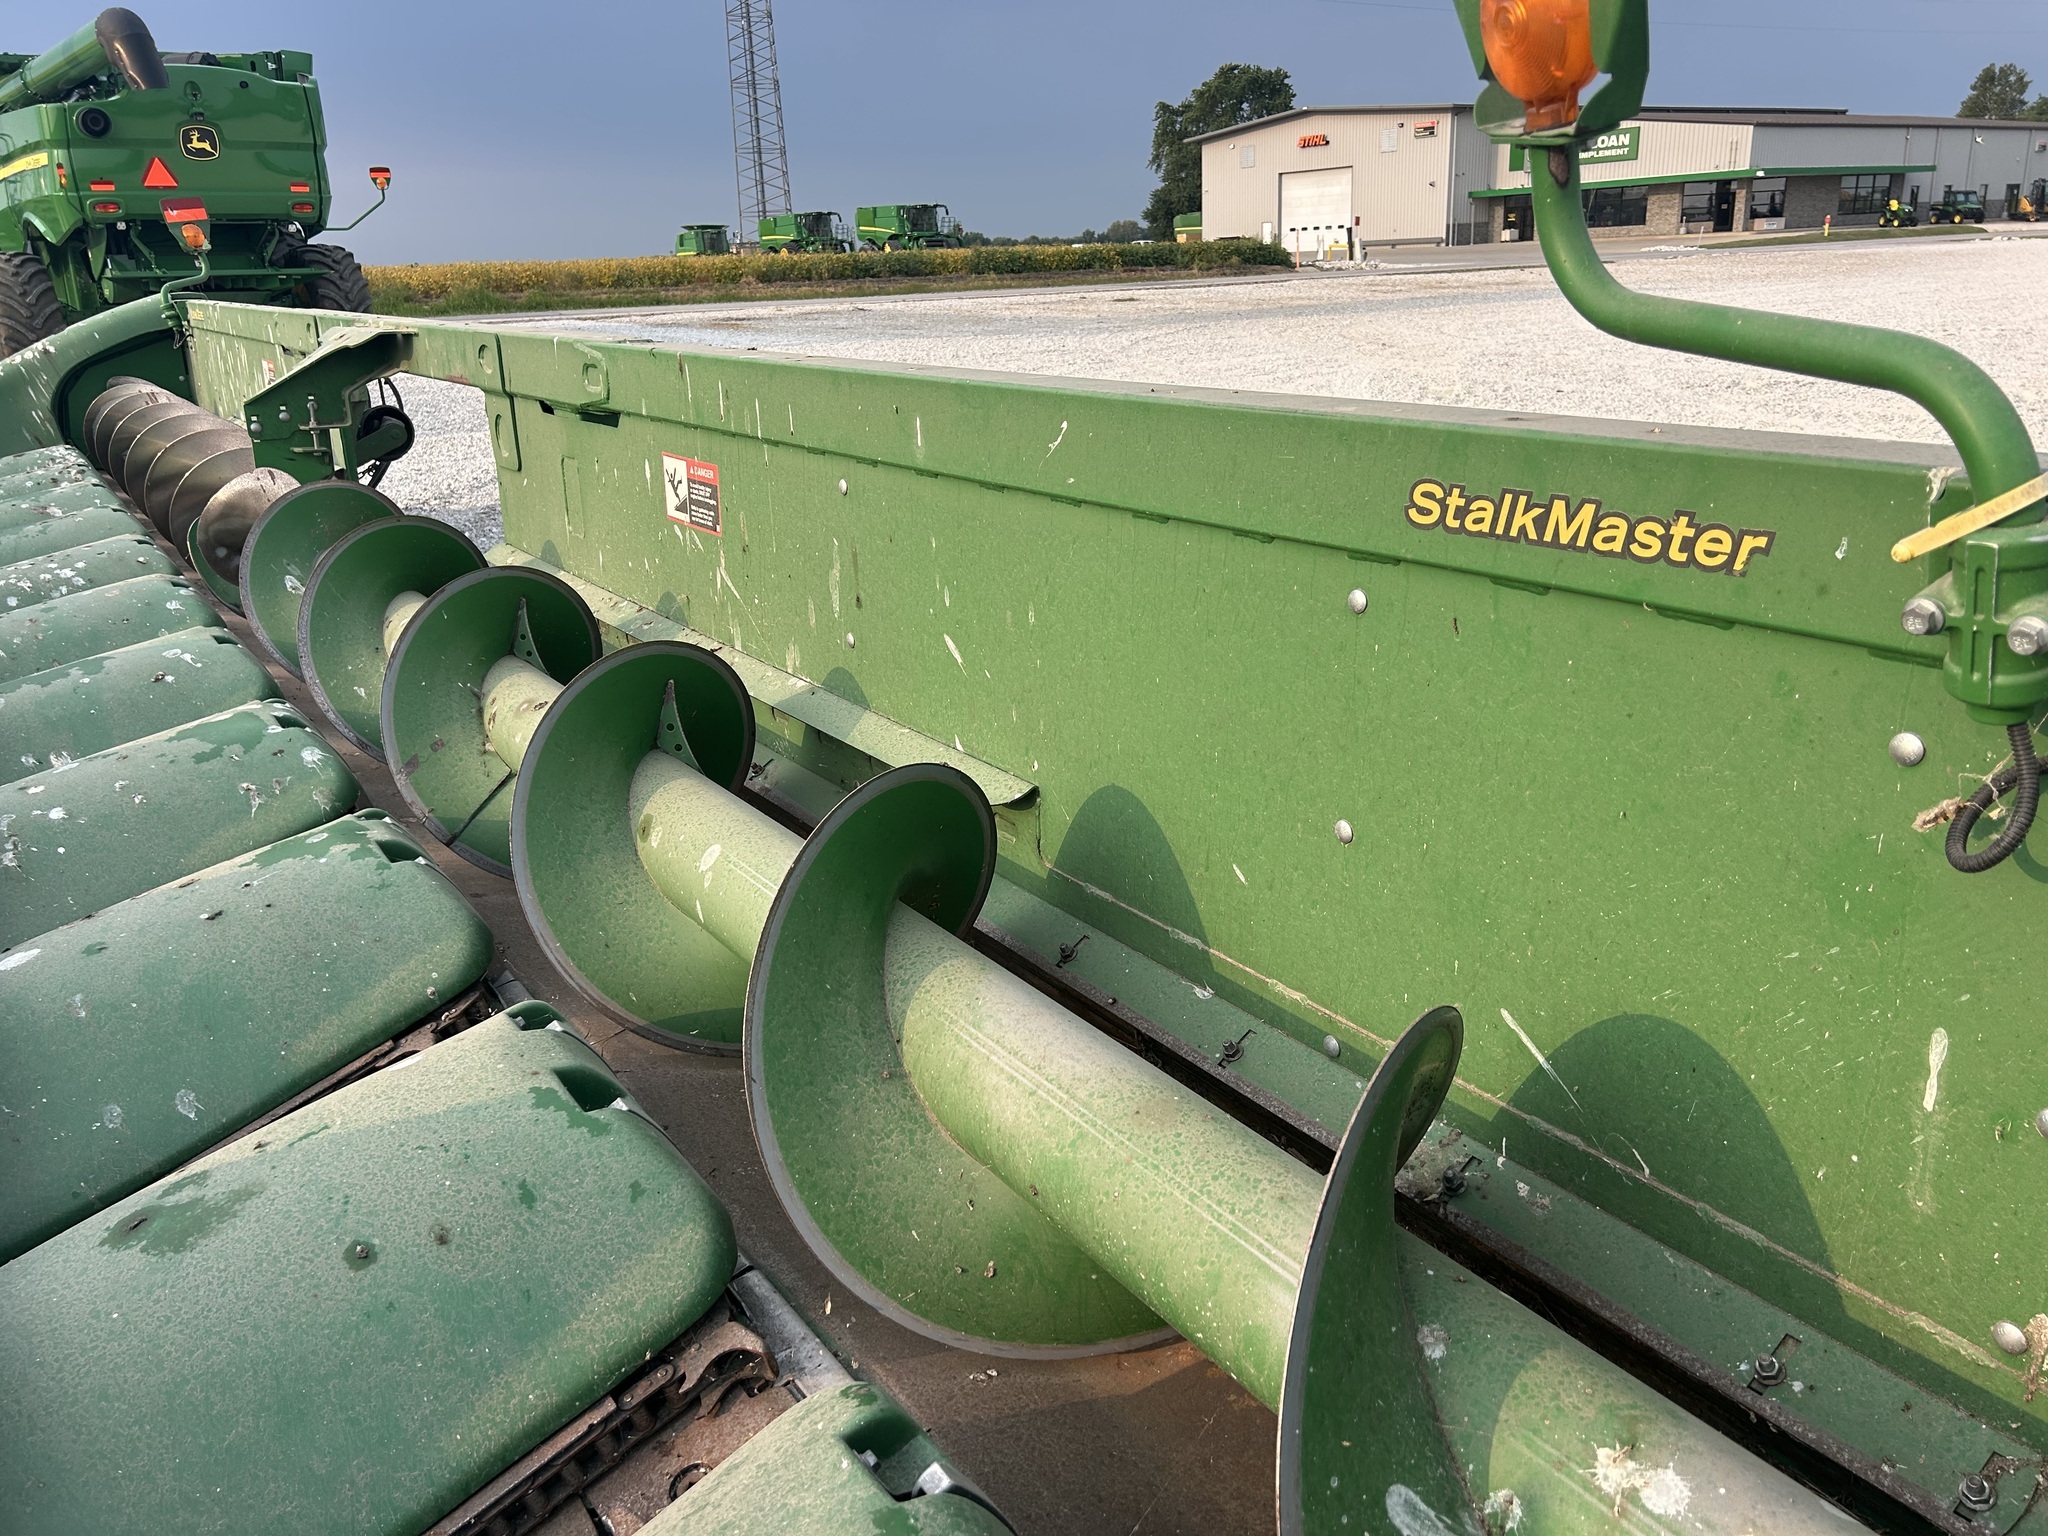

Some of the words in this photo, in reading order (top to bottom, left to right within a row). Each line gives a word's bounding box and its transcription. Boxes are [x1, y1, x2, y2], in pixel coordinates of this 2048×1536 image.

[1297, 133, 1328, 148] STIHL
[1578, 147, 1630, 159] IMPLEMENT
[1406, 480, 1771, 574] StalkMaster
